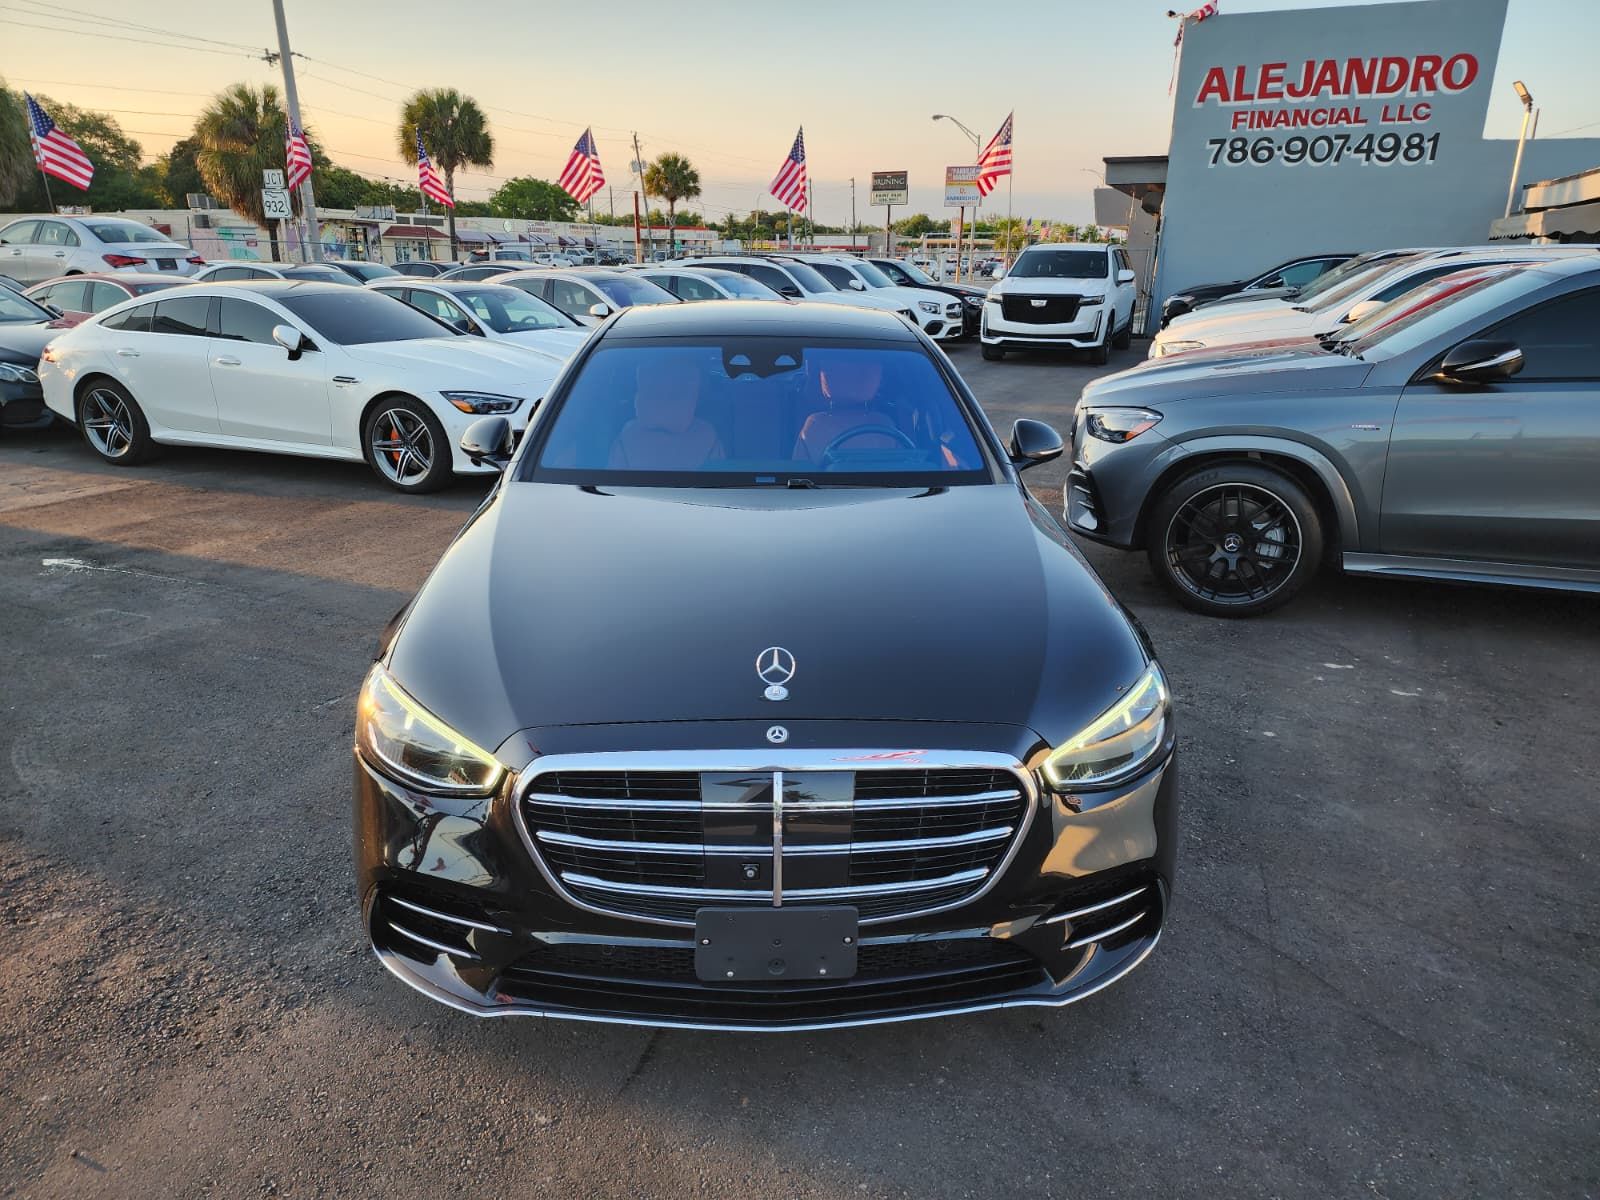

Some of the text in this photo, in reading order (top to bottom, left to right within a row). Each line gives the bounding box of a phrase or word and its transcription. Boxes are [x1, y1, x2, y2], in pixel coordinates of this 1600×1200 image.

[1194, 53, 1479, 106] ALEJANDRO
[1230, 102, 1432, 131] FINANCIAL LLC
[265, 172, 282, 185] JCT
[265, 200, 285, 212] 932
